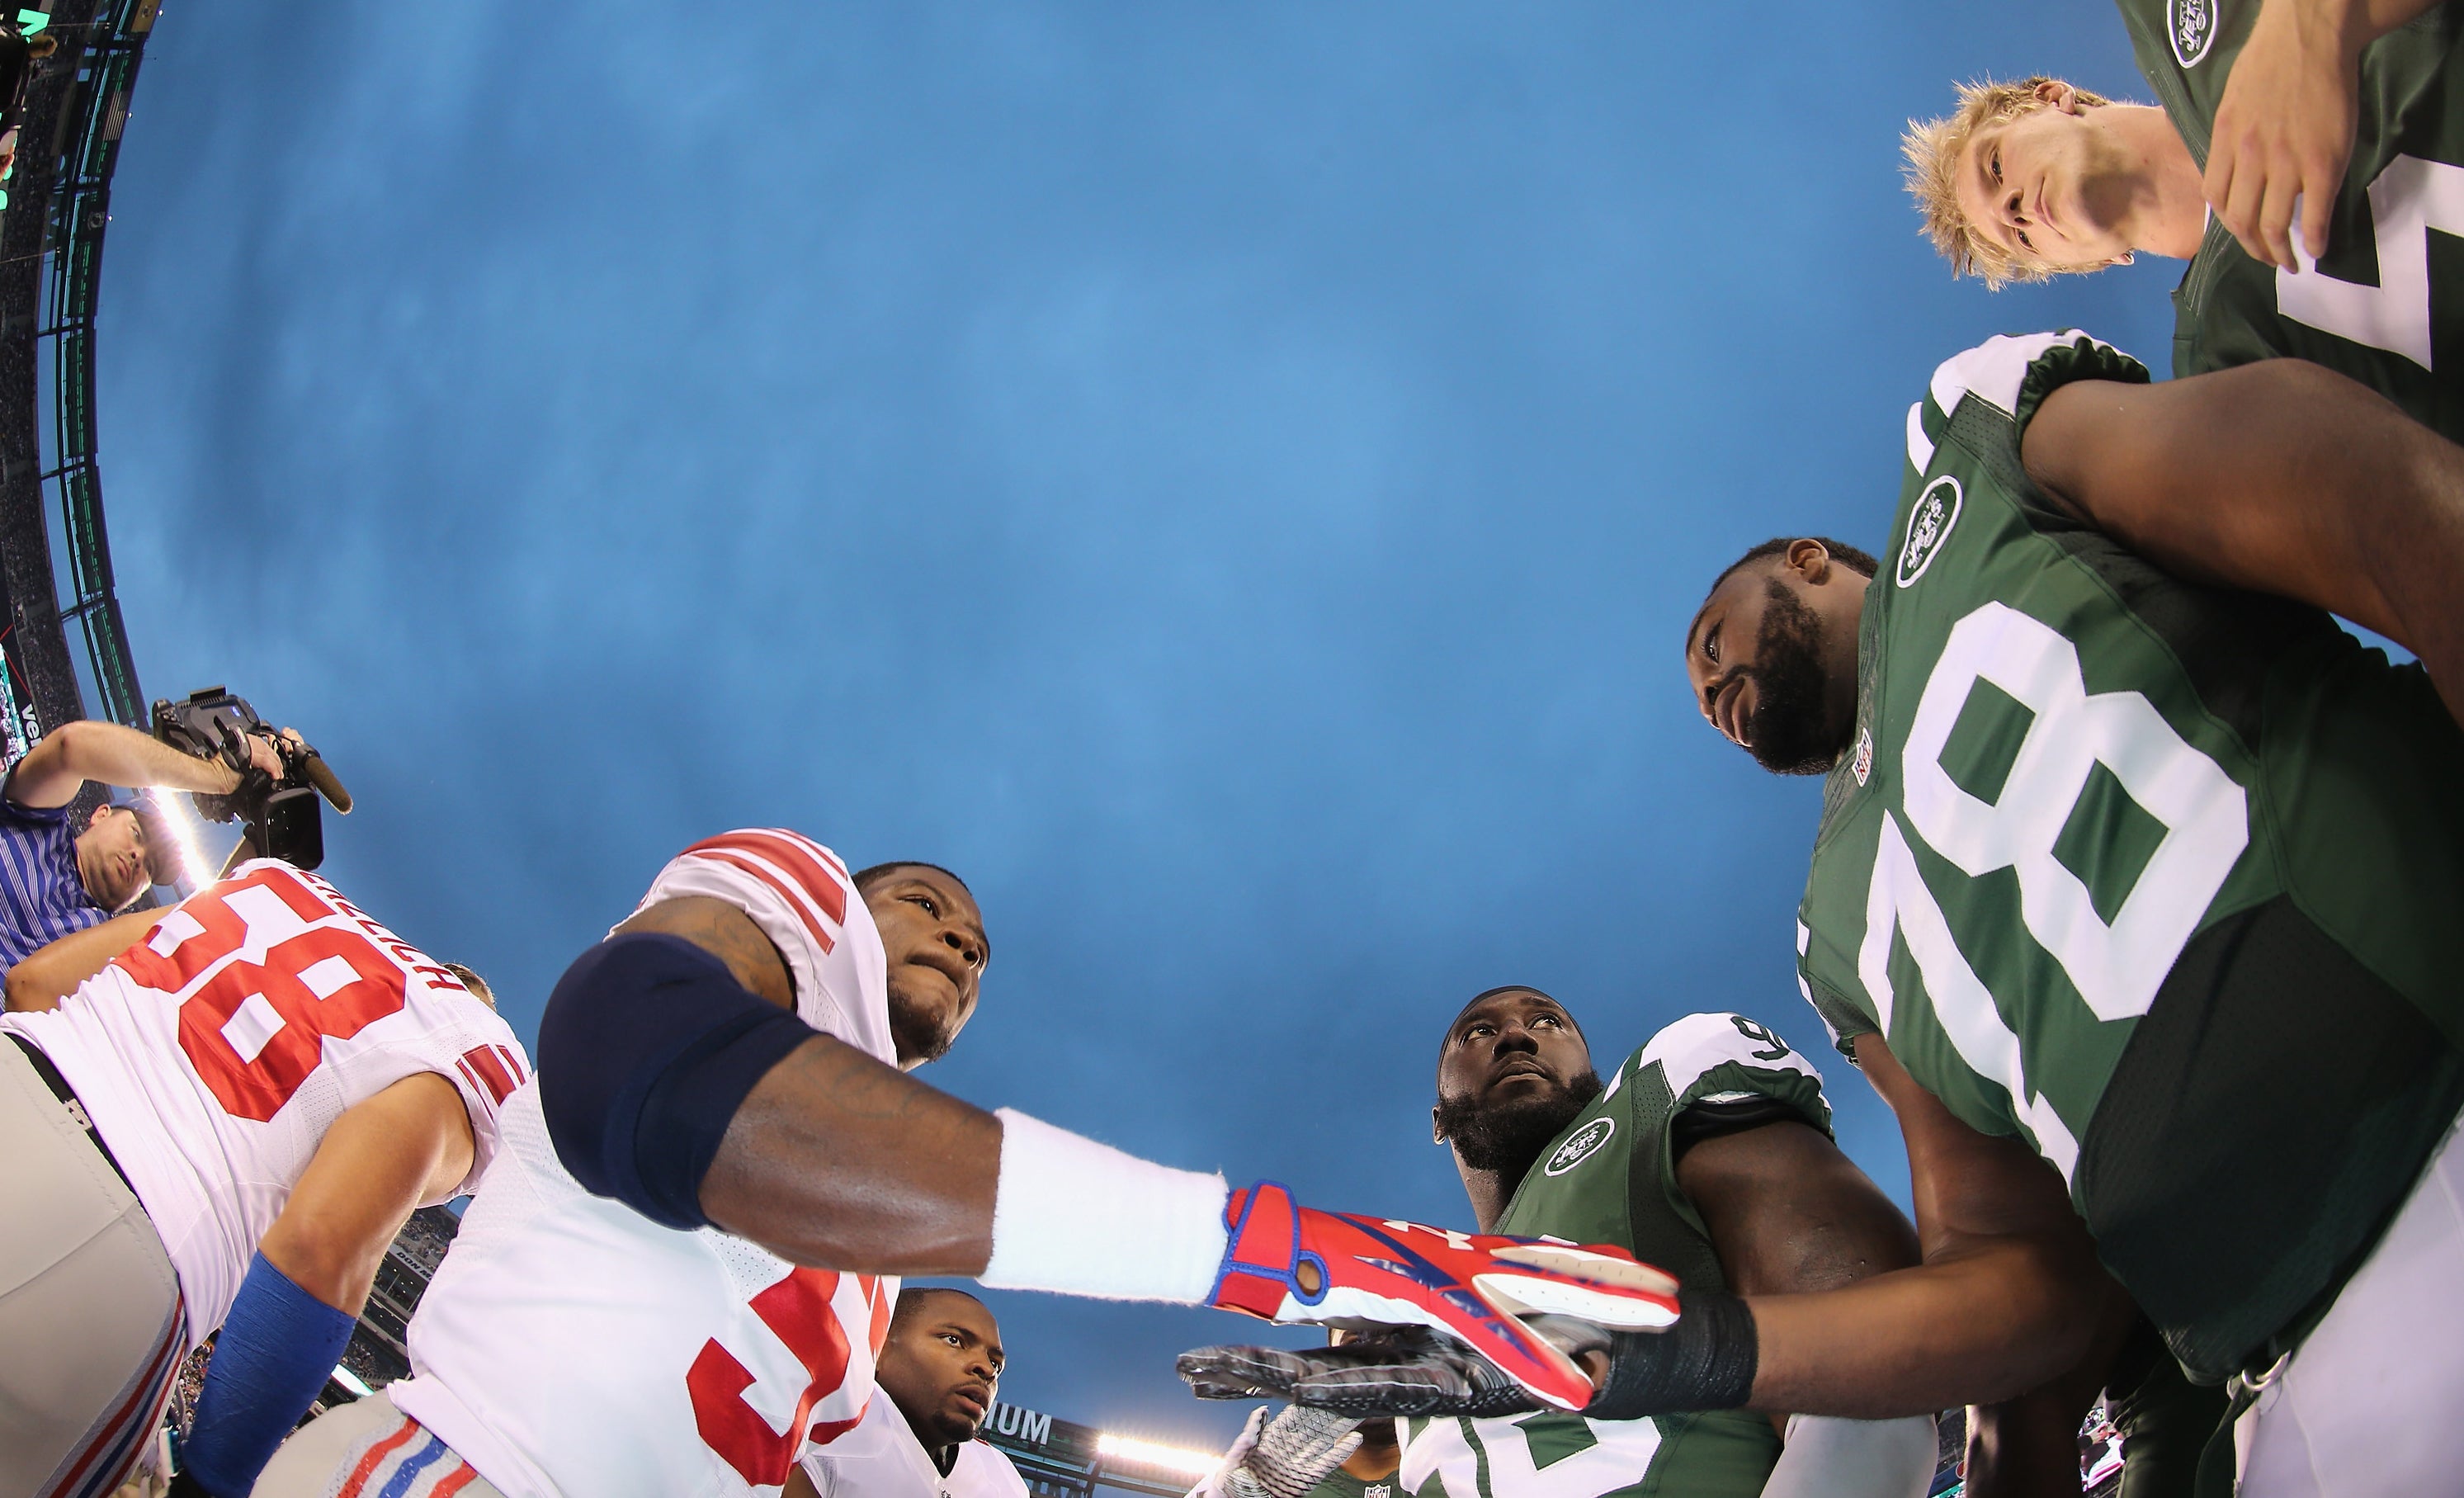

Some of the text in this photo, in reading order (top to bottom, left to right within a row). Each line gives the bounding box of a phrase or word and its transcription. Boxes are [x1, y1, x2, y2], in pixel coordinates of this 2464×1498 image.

[288, 867, 469, 992] ERZLICH
[1858, 600, 2249, 1196] 78
[111, 865, 404, 1122] 58
[1730, 1016, 1791, 1061] 9
[397, 1252, 433, 1281] DON M
